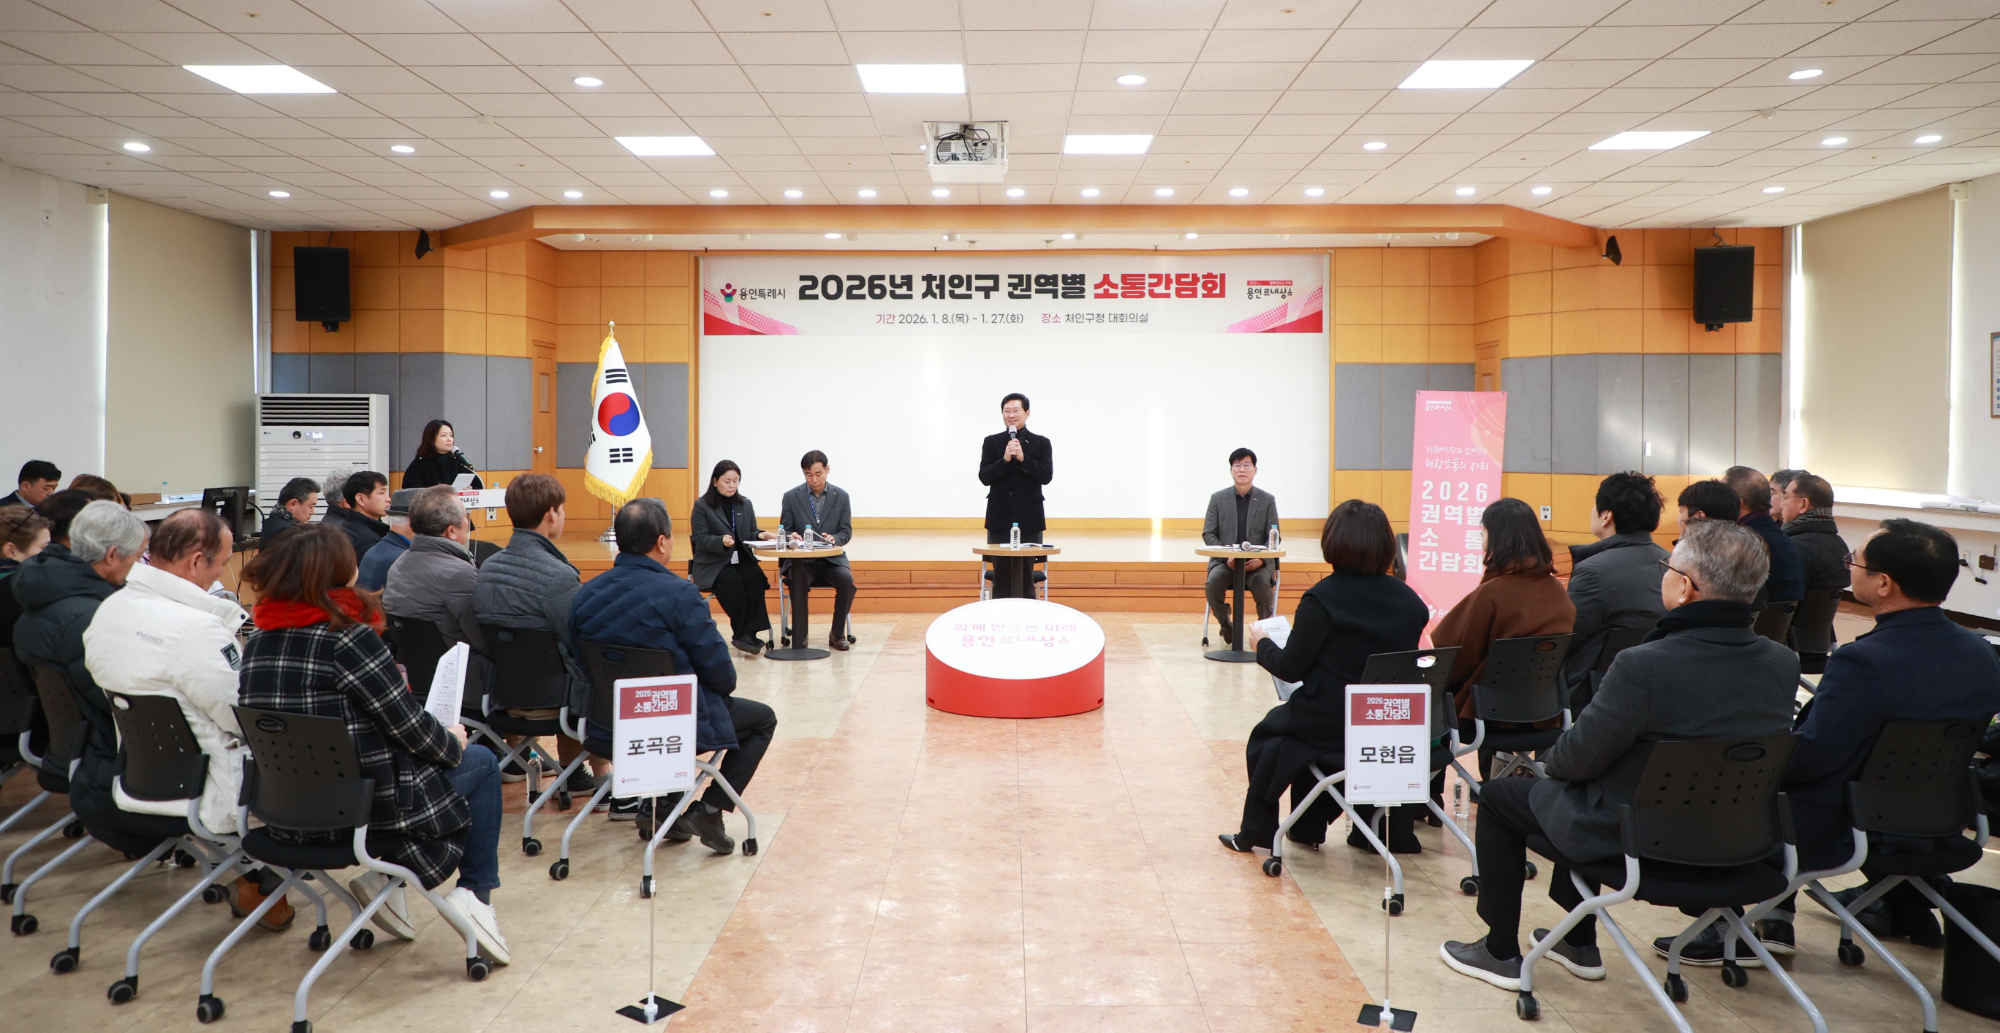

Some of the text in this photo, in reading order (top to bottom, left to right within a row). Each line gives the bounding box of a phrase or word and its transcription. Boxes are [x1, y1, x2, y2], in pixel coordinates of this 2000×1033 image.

[739, 287, 786, 301] 용인특례시
[798, 272, 1226, 301] 2026년 처인구 권역별 소통간담회
[875, 313, 896, 325] 기간
[898, 313, 929, 325] 2026.
[931, 313, 939, 325] 1.
[941, 313, 970, 325] 8.(목)
[981, 313, 989, 325] 1.
[991, 313, 1024, 325] 27.(화)
[1041, 313, 1062, 325] 장소
[1064, 312, 1105, 325] 처인구청
[1108, 312, 1149, 325] 대회의실
[1469, 461, 1489, 473] 자리
[1421, 480, 1488, 503] 2026
[1421, 504, 1485, 526] 권역별
[1419, 527, 1483, 550] 소통
[1418, 551, 1484, 575] 간담회
[991, 623, 1039, 632] 만드는
[1045, 623, 1077, 632] 미래
[960, 634, 1071, 648] 용인 르네상스
[634, 699, 678, 713] 소통간담회
[1365, 708, 1411, 720] 소통간담회
[627, 735, 683, 756] 포곡읍
[1359, 745, 1416, 764] 모현읍
